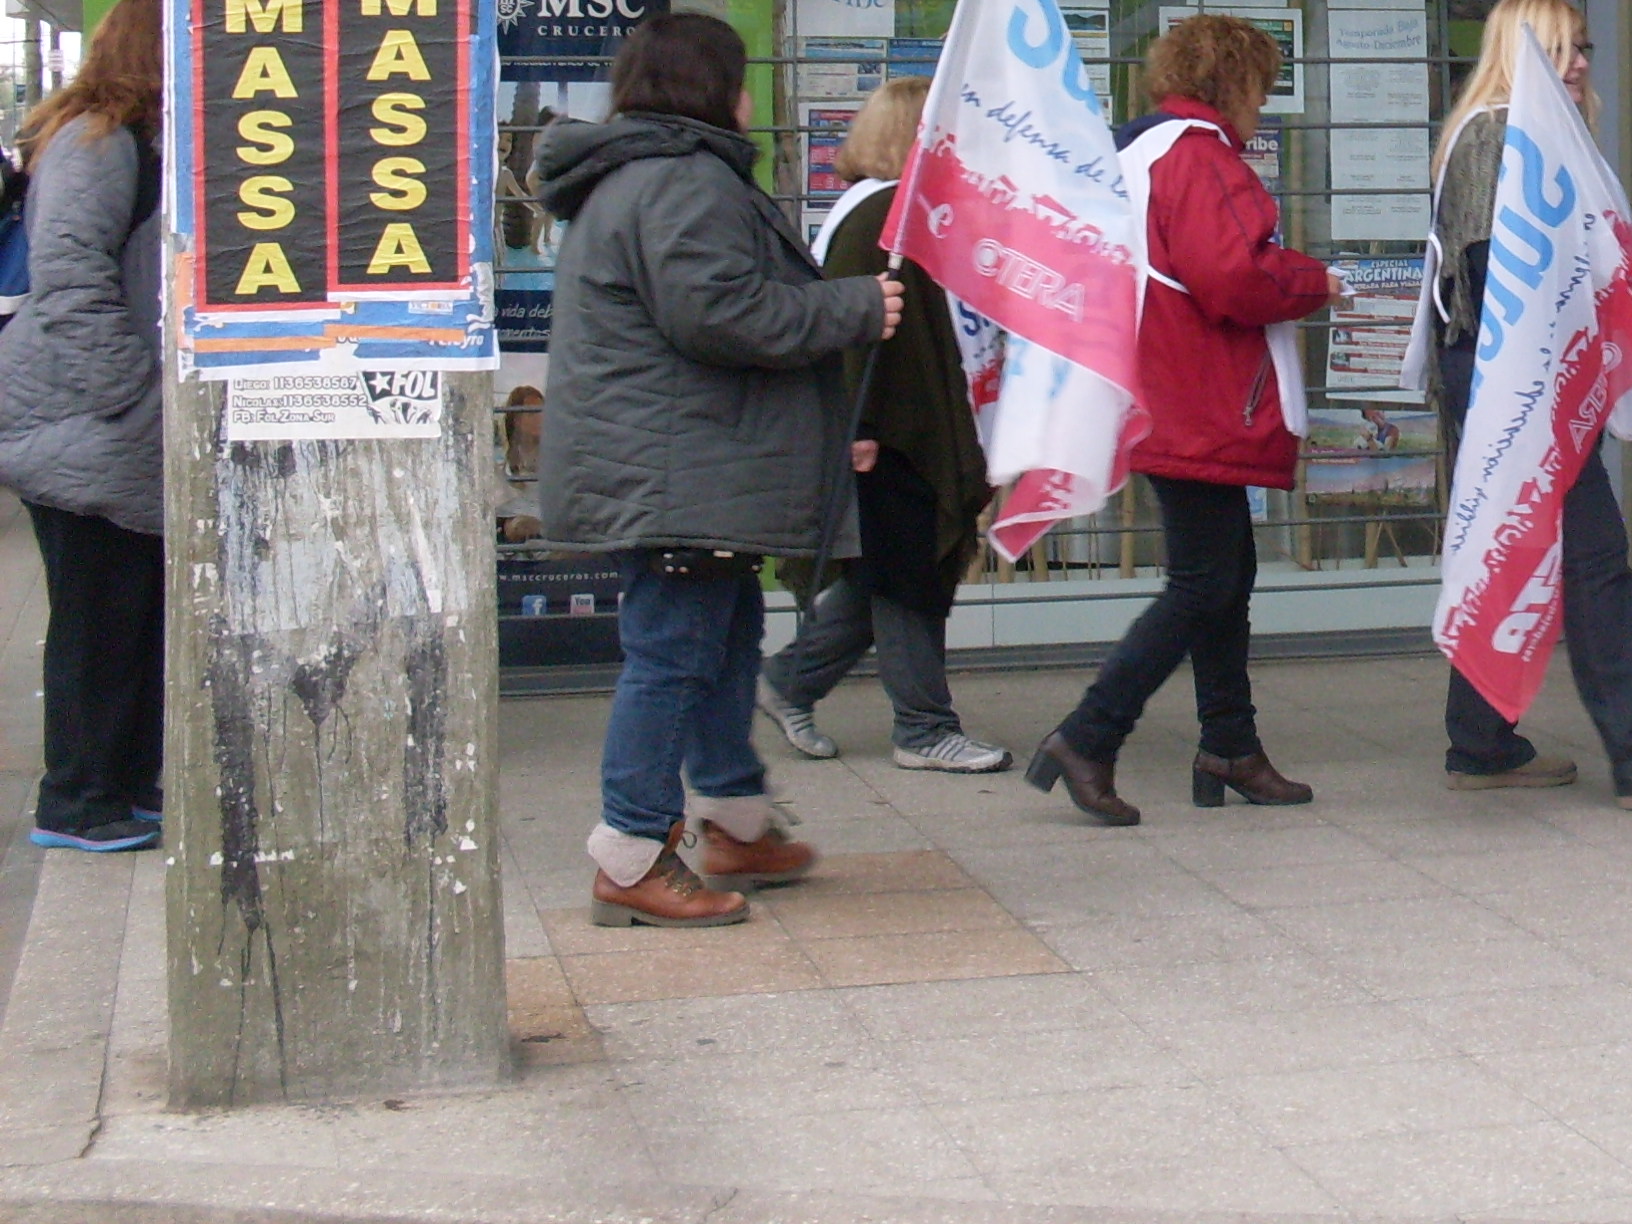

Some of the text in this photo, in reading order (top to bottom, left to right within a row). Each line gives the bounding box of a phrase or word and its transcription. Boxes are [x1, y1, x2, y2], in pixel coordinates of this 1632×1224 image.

[986, 101, 1071, 164] defensa
[1075, 156, 1104, 183] de
[1244, 136, 1279, 152] ribe
[972, 237, 1086, 324] CTERA
[1344, 267, 1423, 283] ARGENTINA
